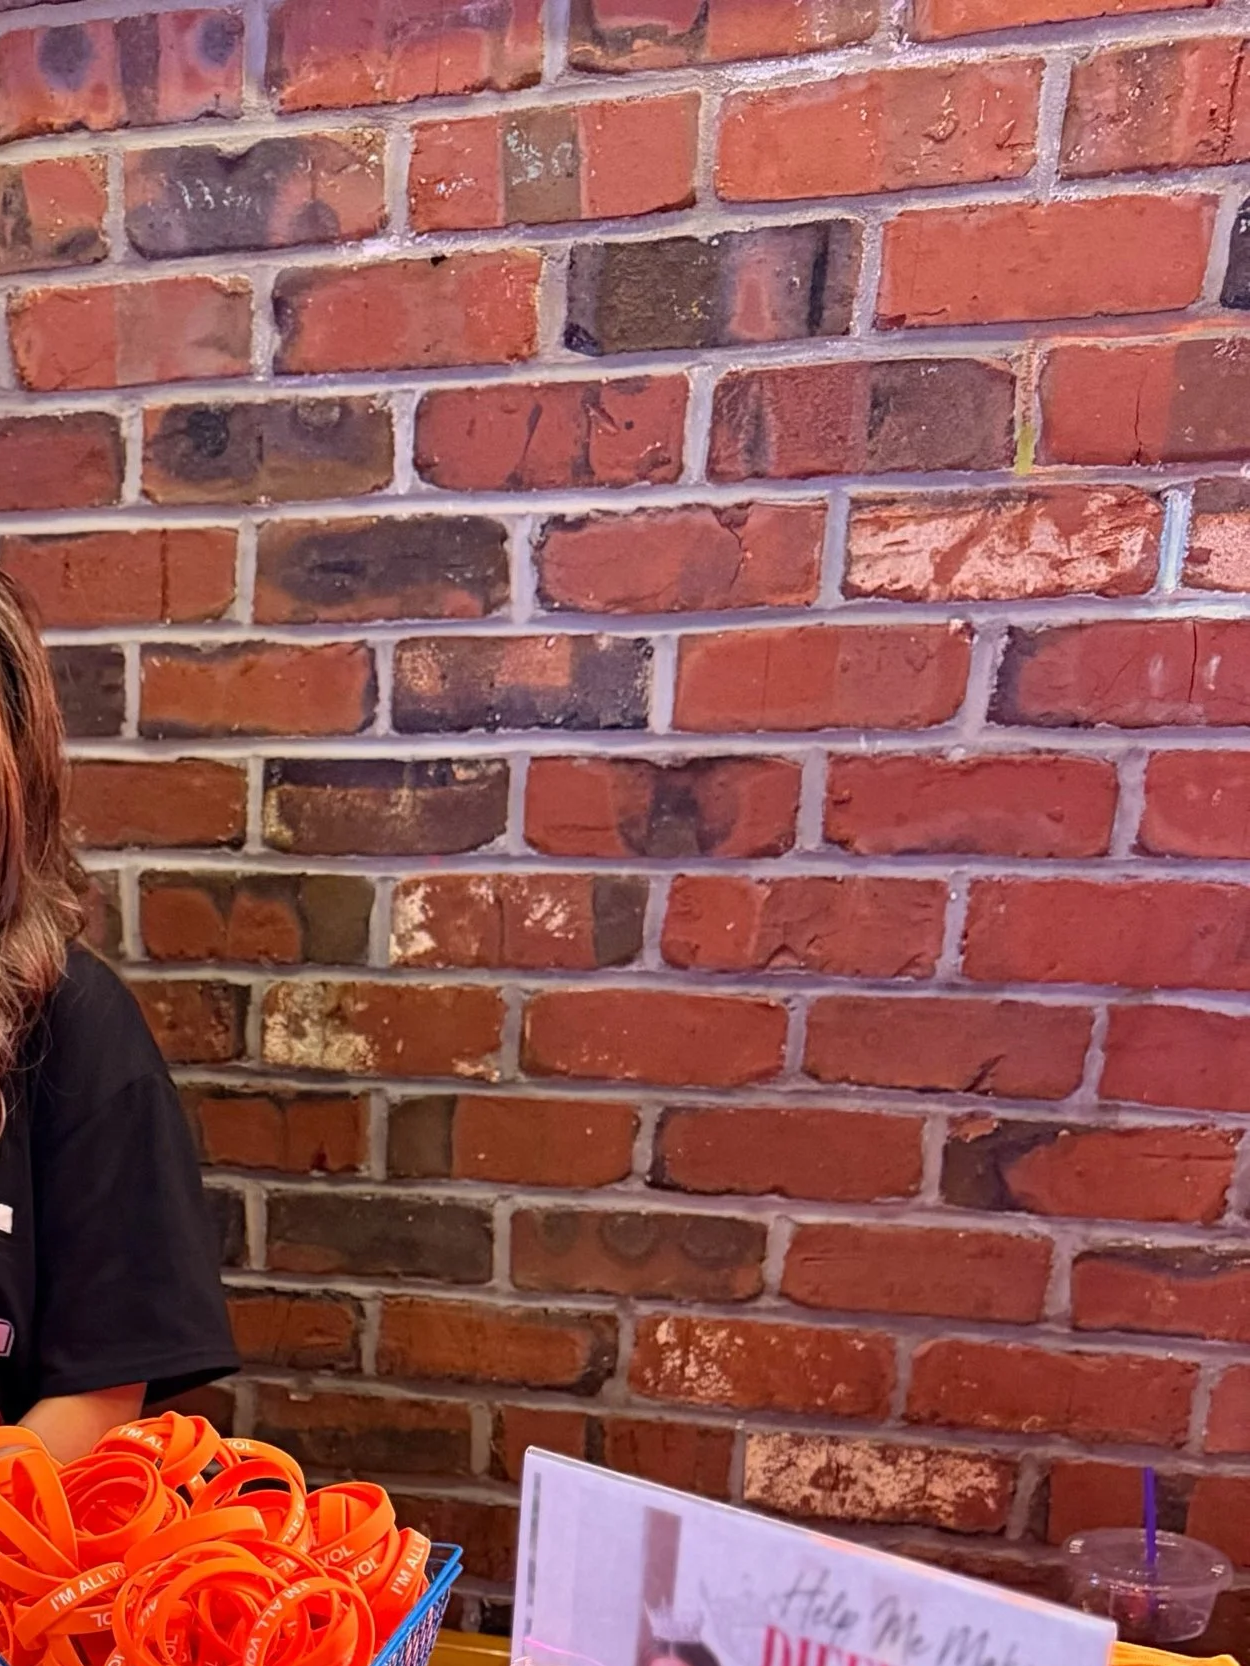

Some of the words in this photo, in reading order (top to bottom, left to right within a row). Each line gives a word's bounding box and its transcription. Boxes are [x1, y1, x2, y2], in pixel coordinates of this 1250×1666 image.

[144, 1436, 164, 1451] AL
[318, 1545, 354, 1567] VOL
[351, 1556, 381, 1581] VOL
[390, 1571, 413, 1596] I'M
[405, 1539, 426, 1569] ALL
[50, 1587, 77, 1612] I'M
[78, 1572, 110, 1596] ALL
[107, 1566, 127, 1580] VO
[283, 1581, 311, 1599] I'M
[90, 1612, 113, 1627] OL
[255, 1599, 283, 1630] ALL
[770, 1568, 860, 1645] Help
[870, 1596, 930, 1660] Me
